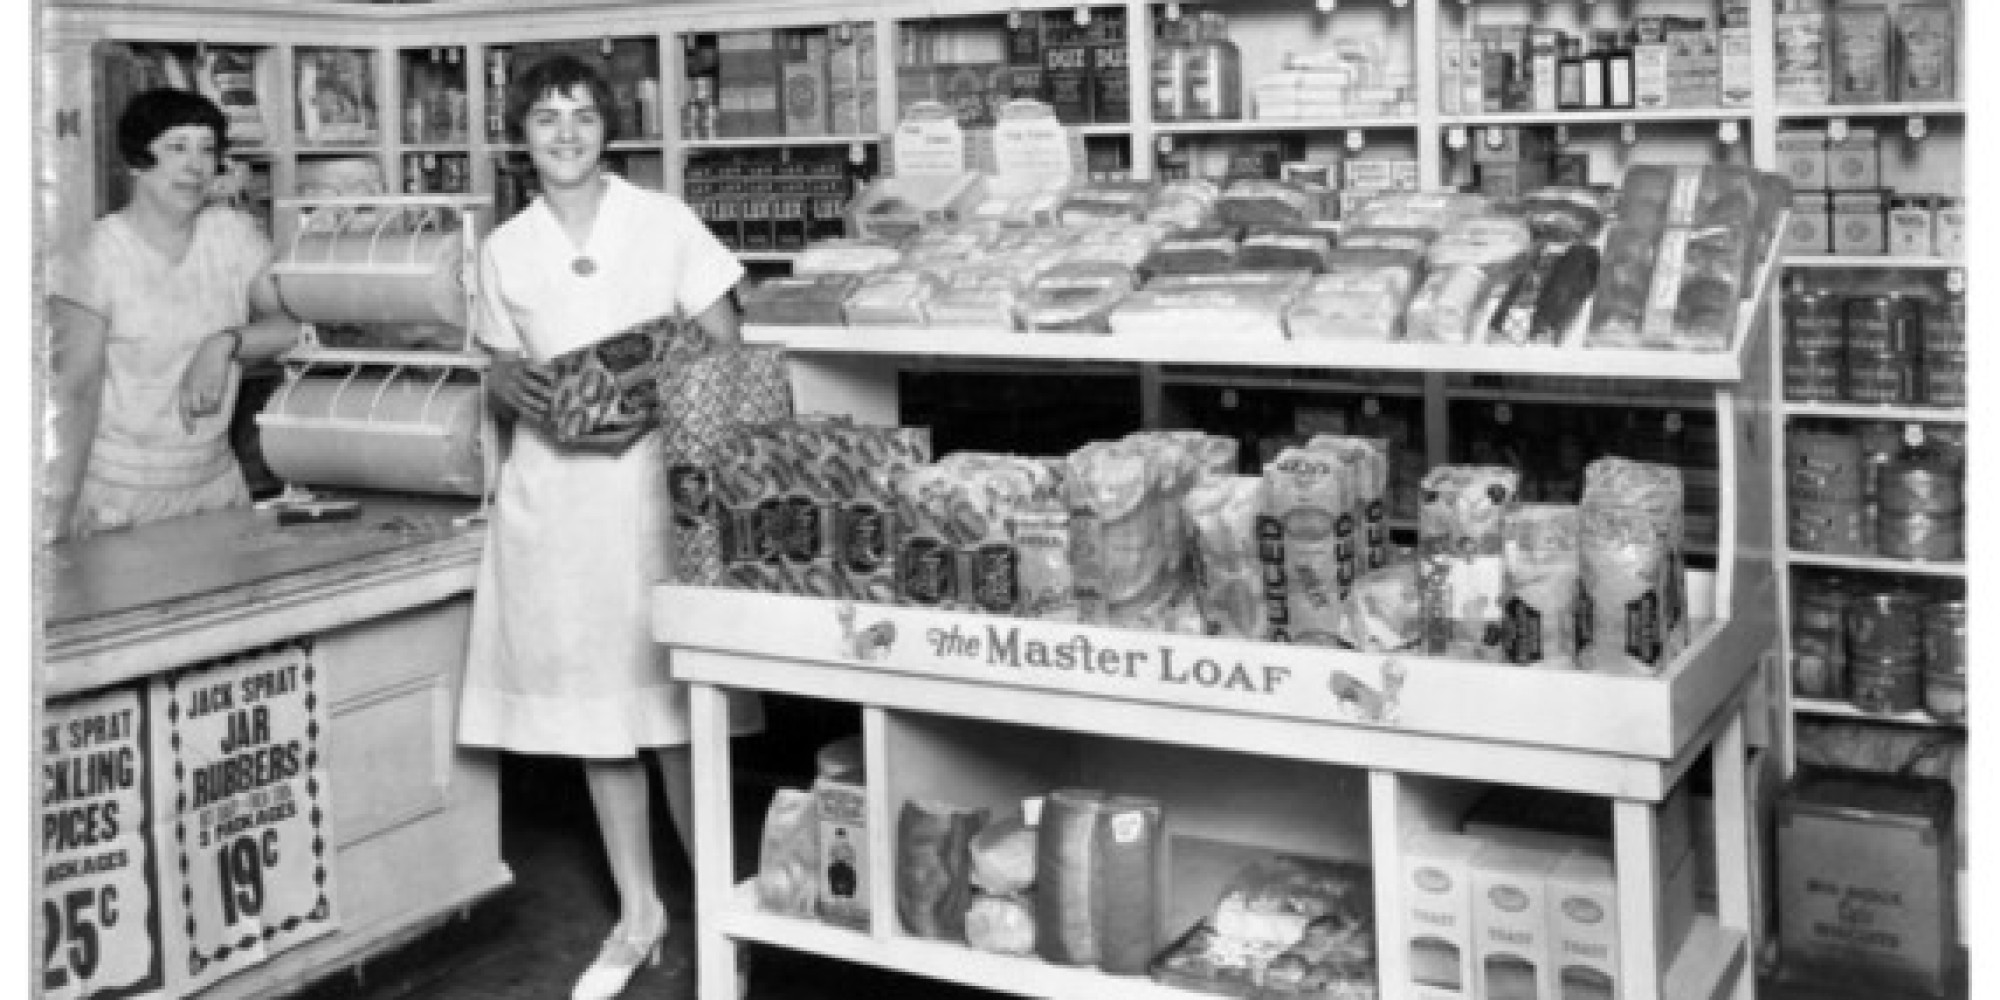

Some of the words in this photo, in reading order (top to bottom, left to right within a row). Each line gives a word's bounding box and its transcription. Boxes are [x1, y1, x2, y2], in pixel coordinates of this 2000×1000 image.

[985, 624, 1148, 679] Master
[1157, 645, 1292, 695] LOAF
[187, 683, 233, 720] JACK
[240, 664, 299, 704] SPRAT
[68, 708, 133, 749] SPRAT
[221, 704, 270, 755] JAR
[193, 740, 300, 811] RUBBERS
